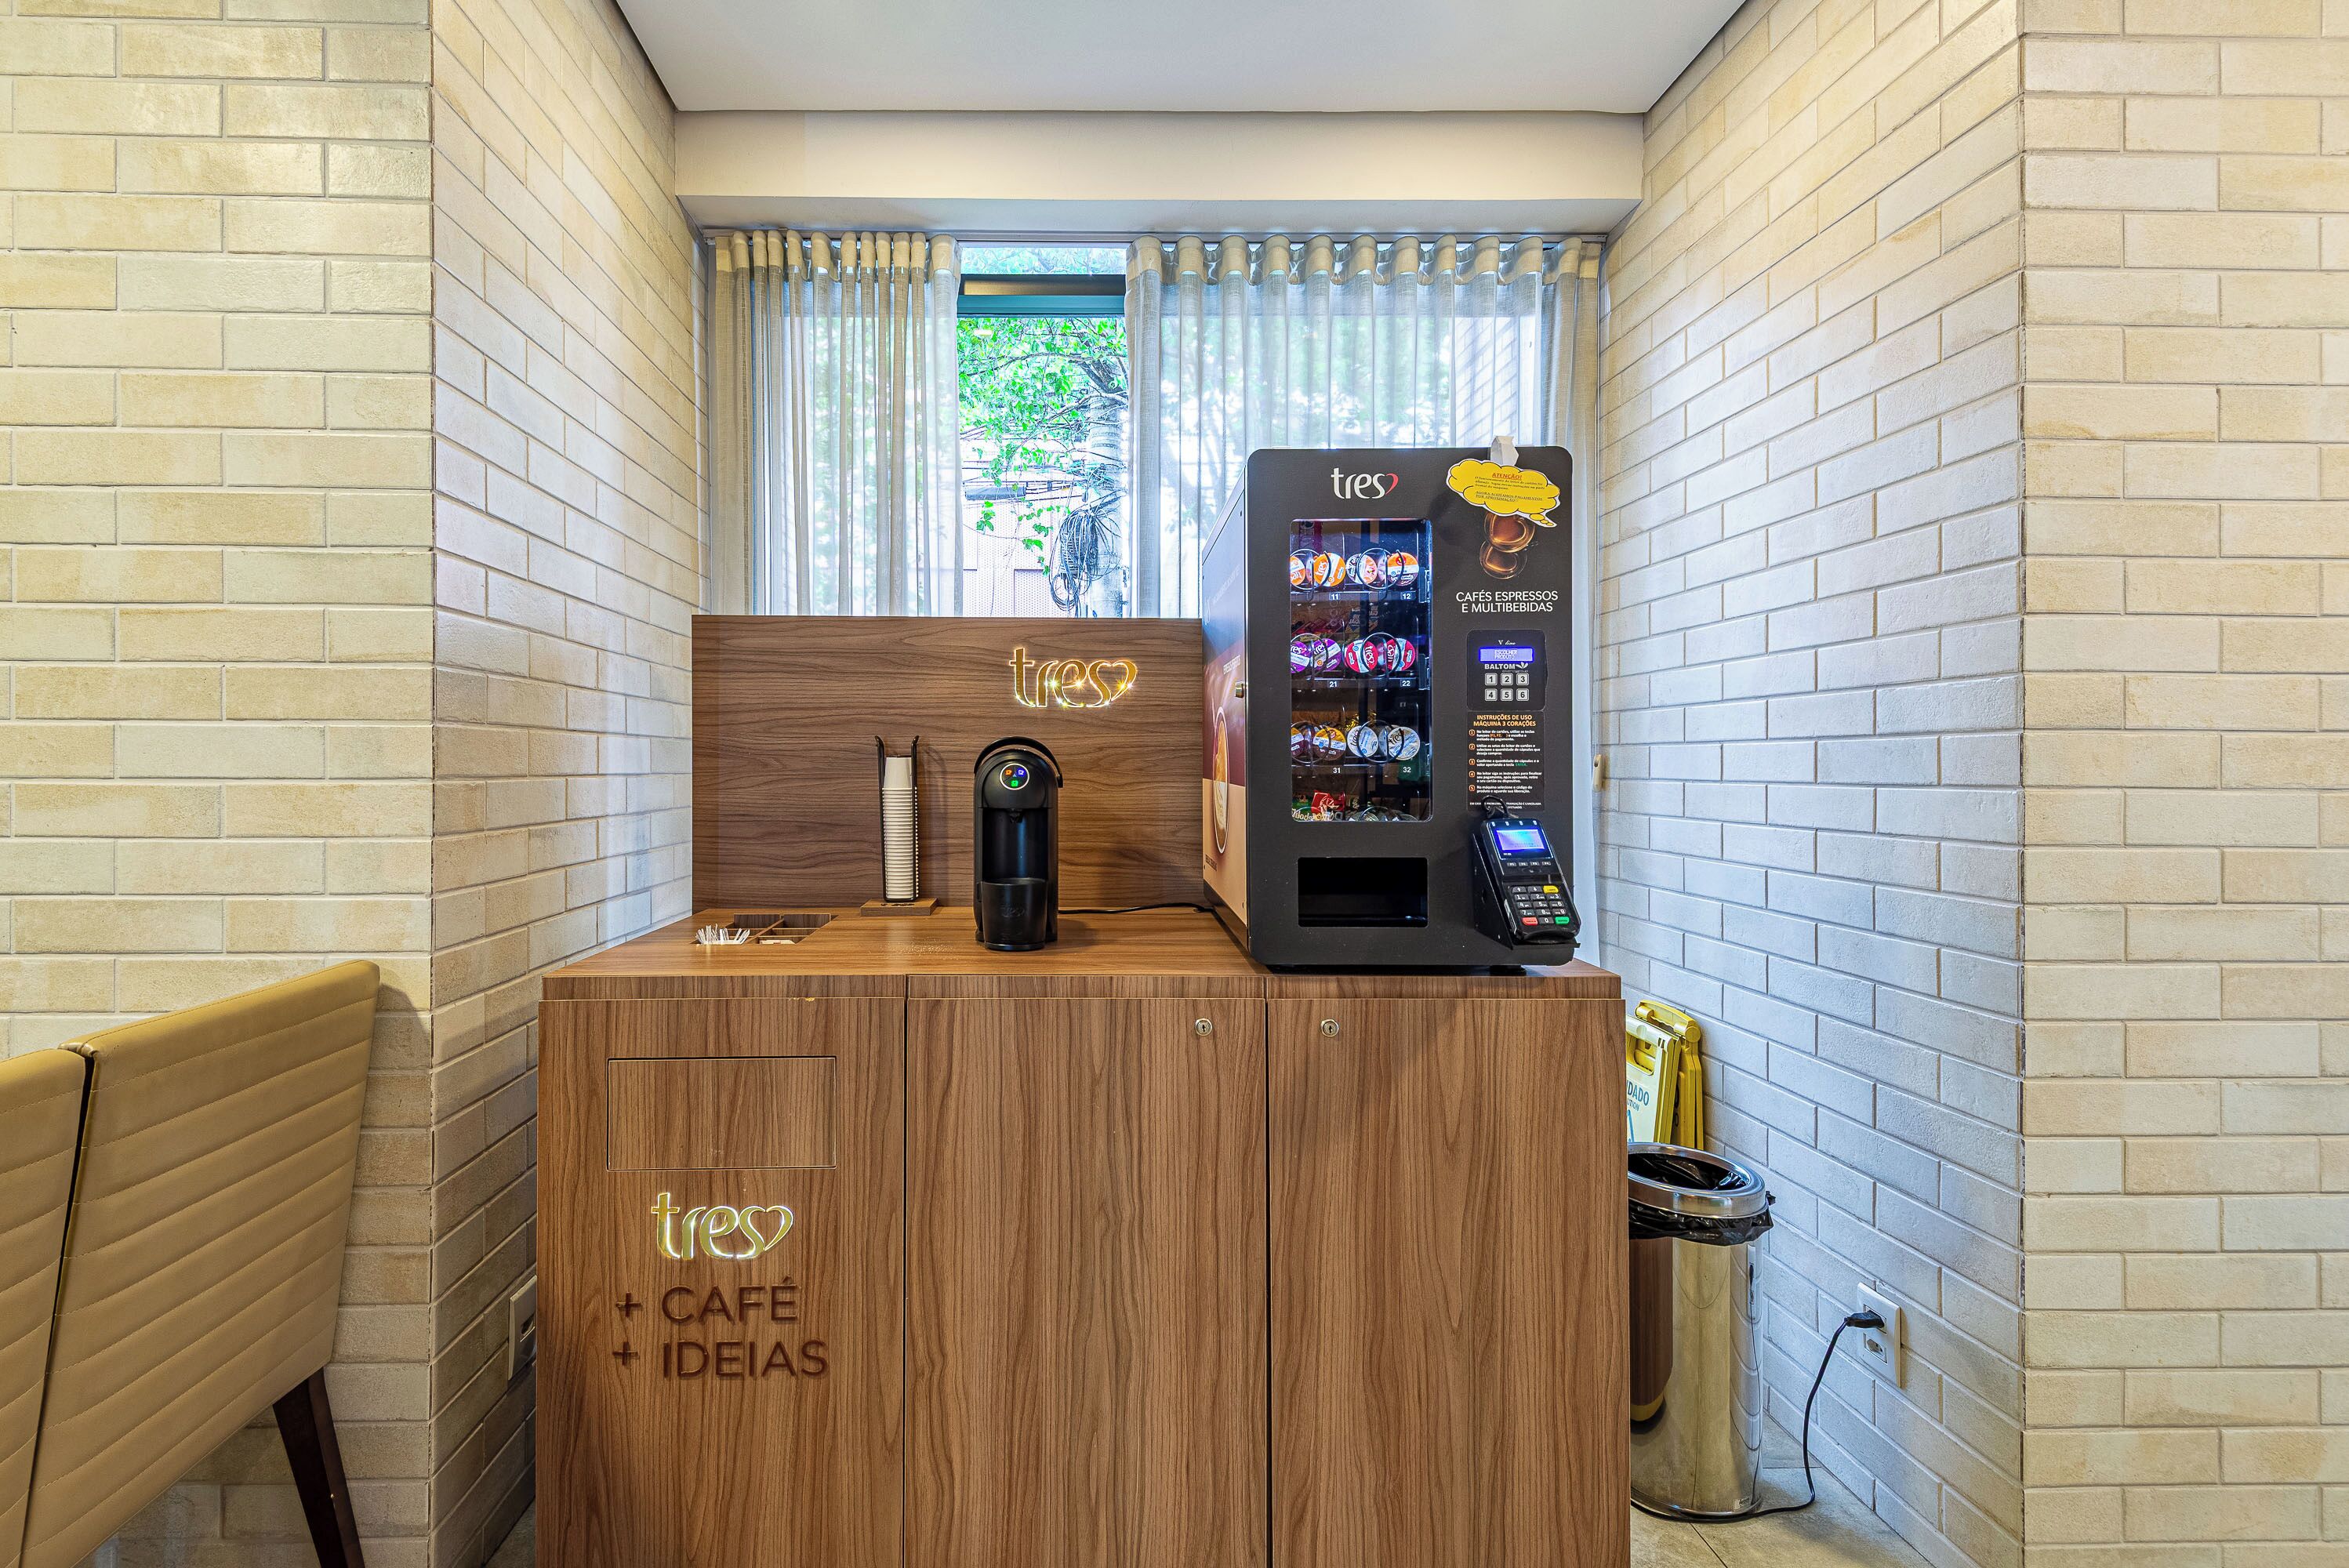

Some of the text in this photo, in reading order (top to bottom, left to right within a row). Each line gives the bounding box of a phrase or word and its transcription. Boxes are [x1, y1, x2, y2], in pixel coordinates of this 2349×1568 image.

[1331, 467, 1385, 499] tres
[1456, 590, 1559, 602] CAFÉS ESPRESSOS
[1461, 602, 1553, 613] E MULTIBEBIDAS
[1009, 648, 1112, 708] tres
[651, 1192, 765, 1261] tres
[660, 1276, 798, 1324] CAFÉ
[663, 1339, 829, 1378] IDEIAS
